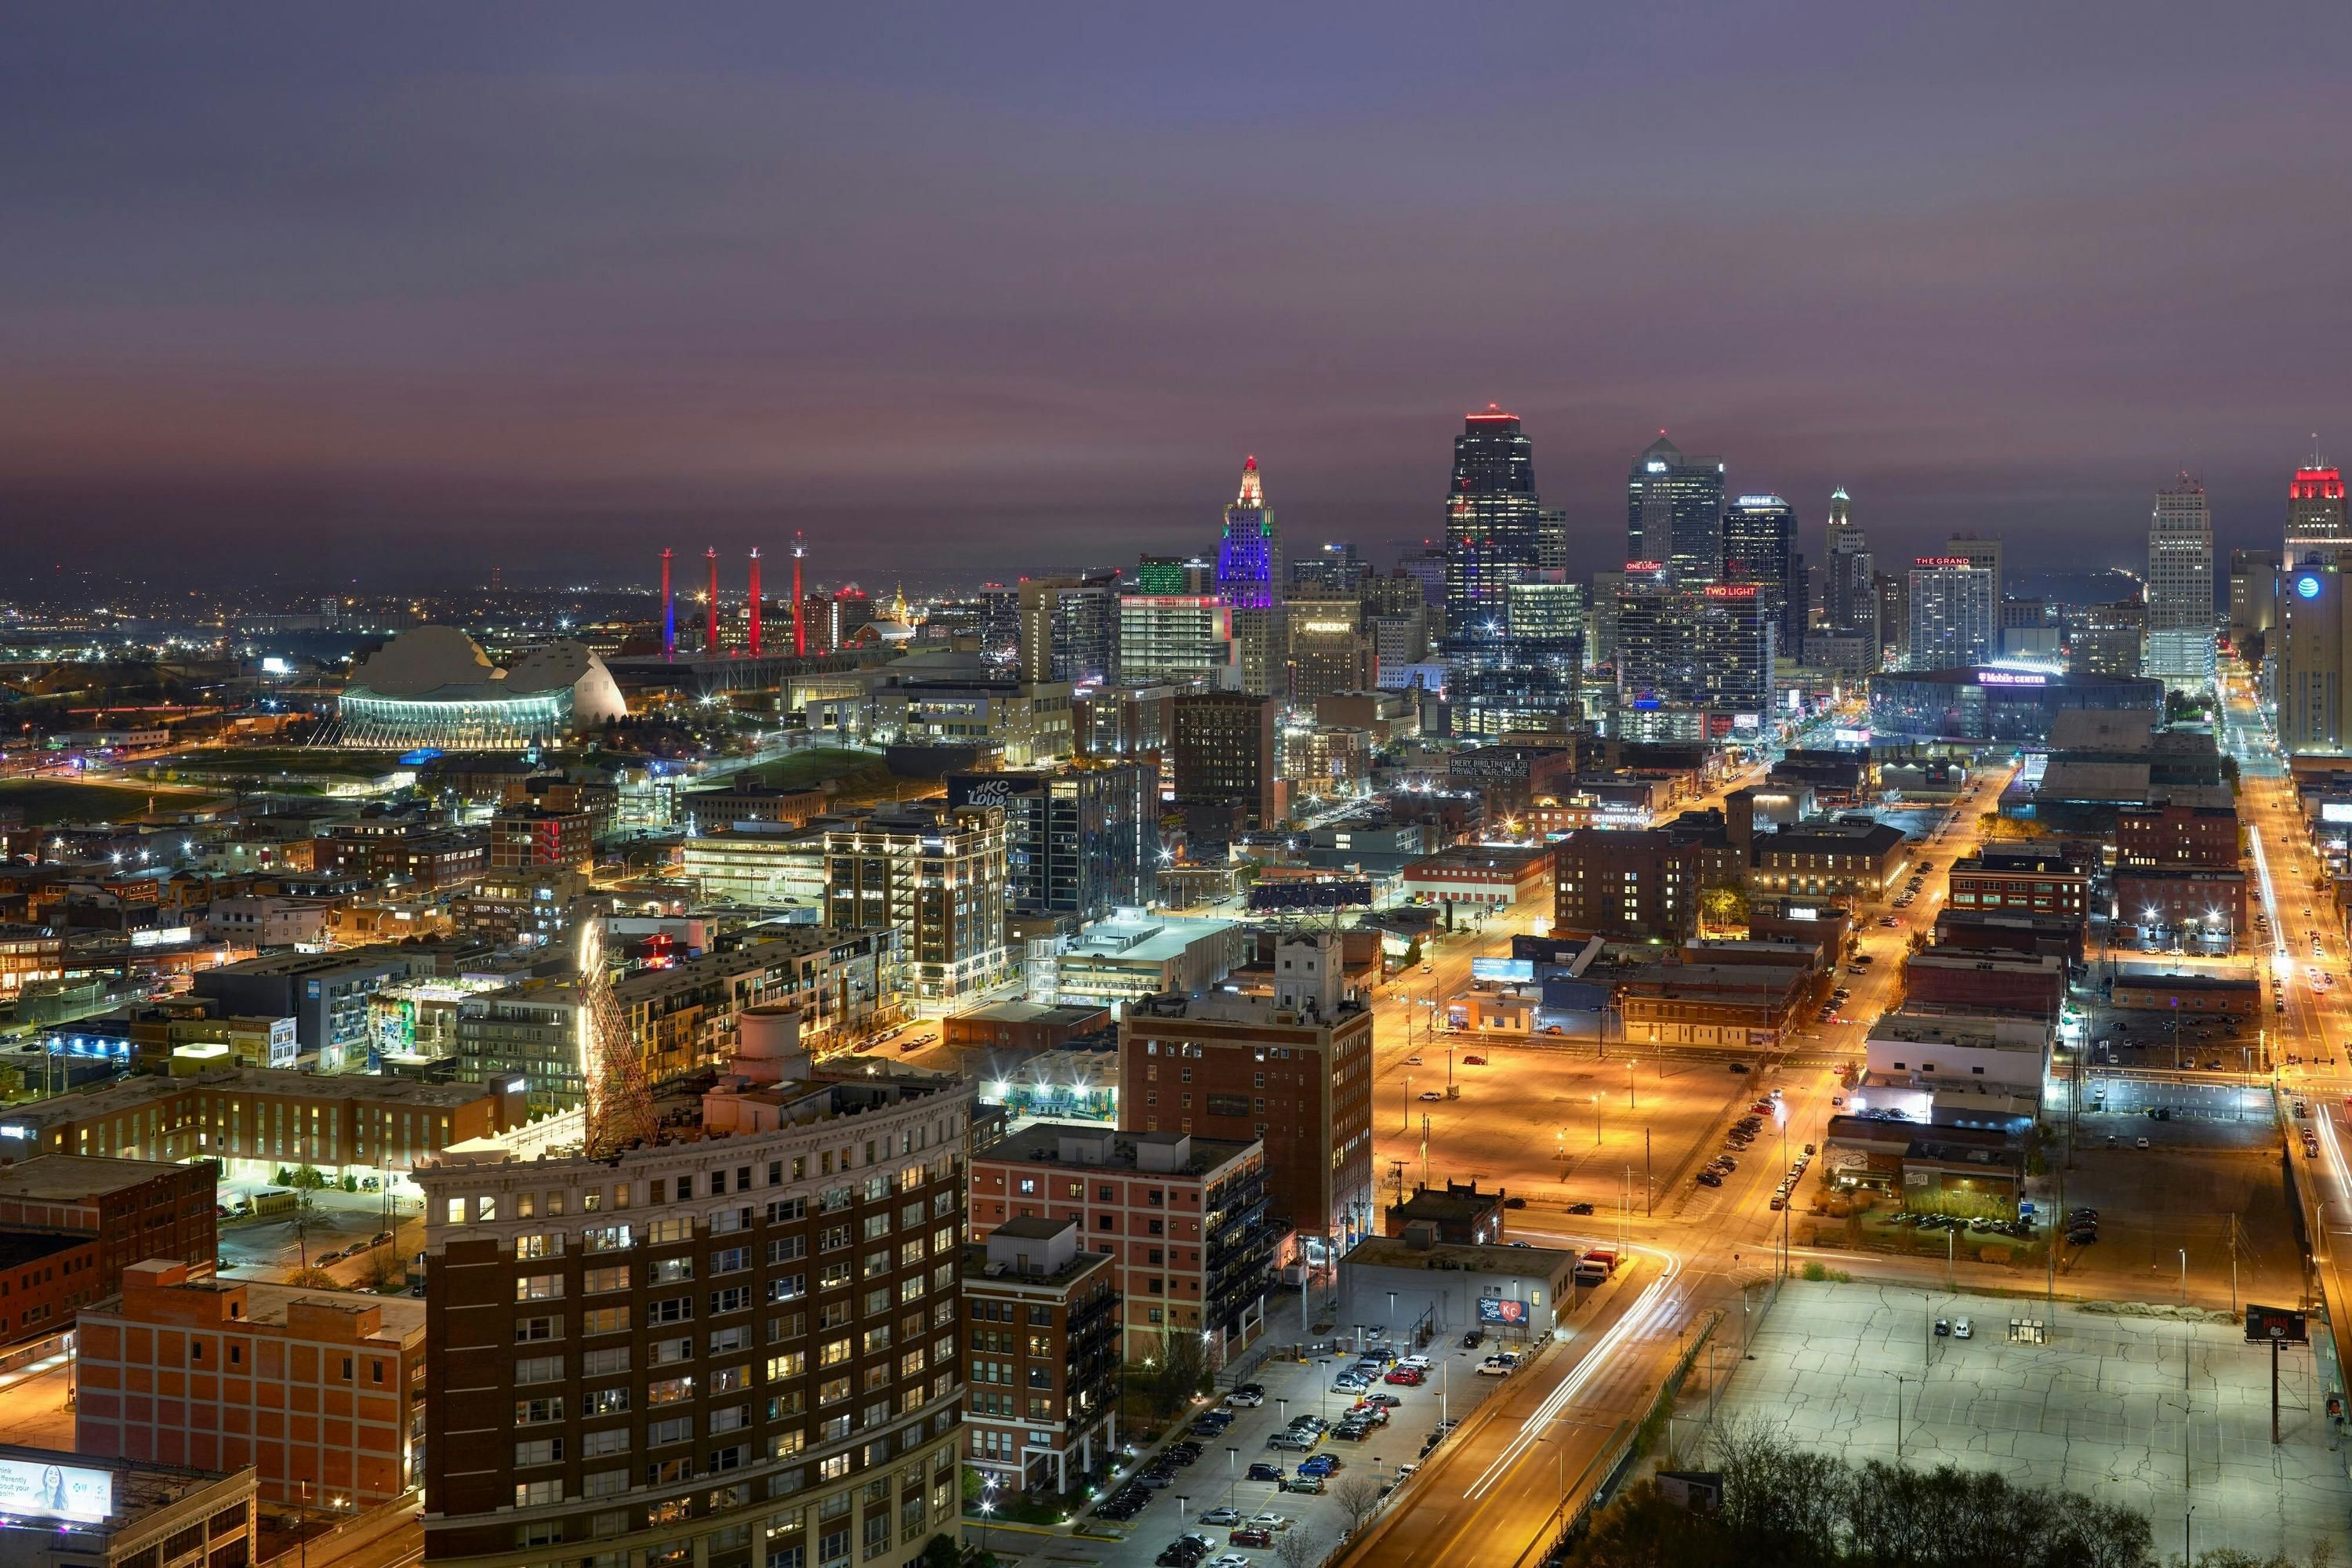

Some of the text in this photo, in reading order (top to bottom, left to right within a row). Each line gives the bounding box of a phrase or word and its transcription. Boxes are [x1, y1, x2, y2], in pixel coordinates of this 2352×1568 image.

[1704, 587, 1755, 596] TWO LIGHT
[1305, 622, 1350, 631] PRESIDENT
[1452, 767, 1527, 777] PRIVATE WAREHOUSE
[1592, 814, 1651, 823] SCIENTOLOGY
